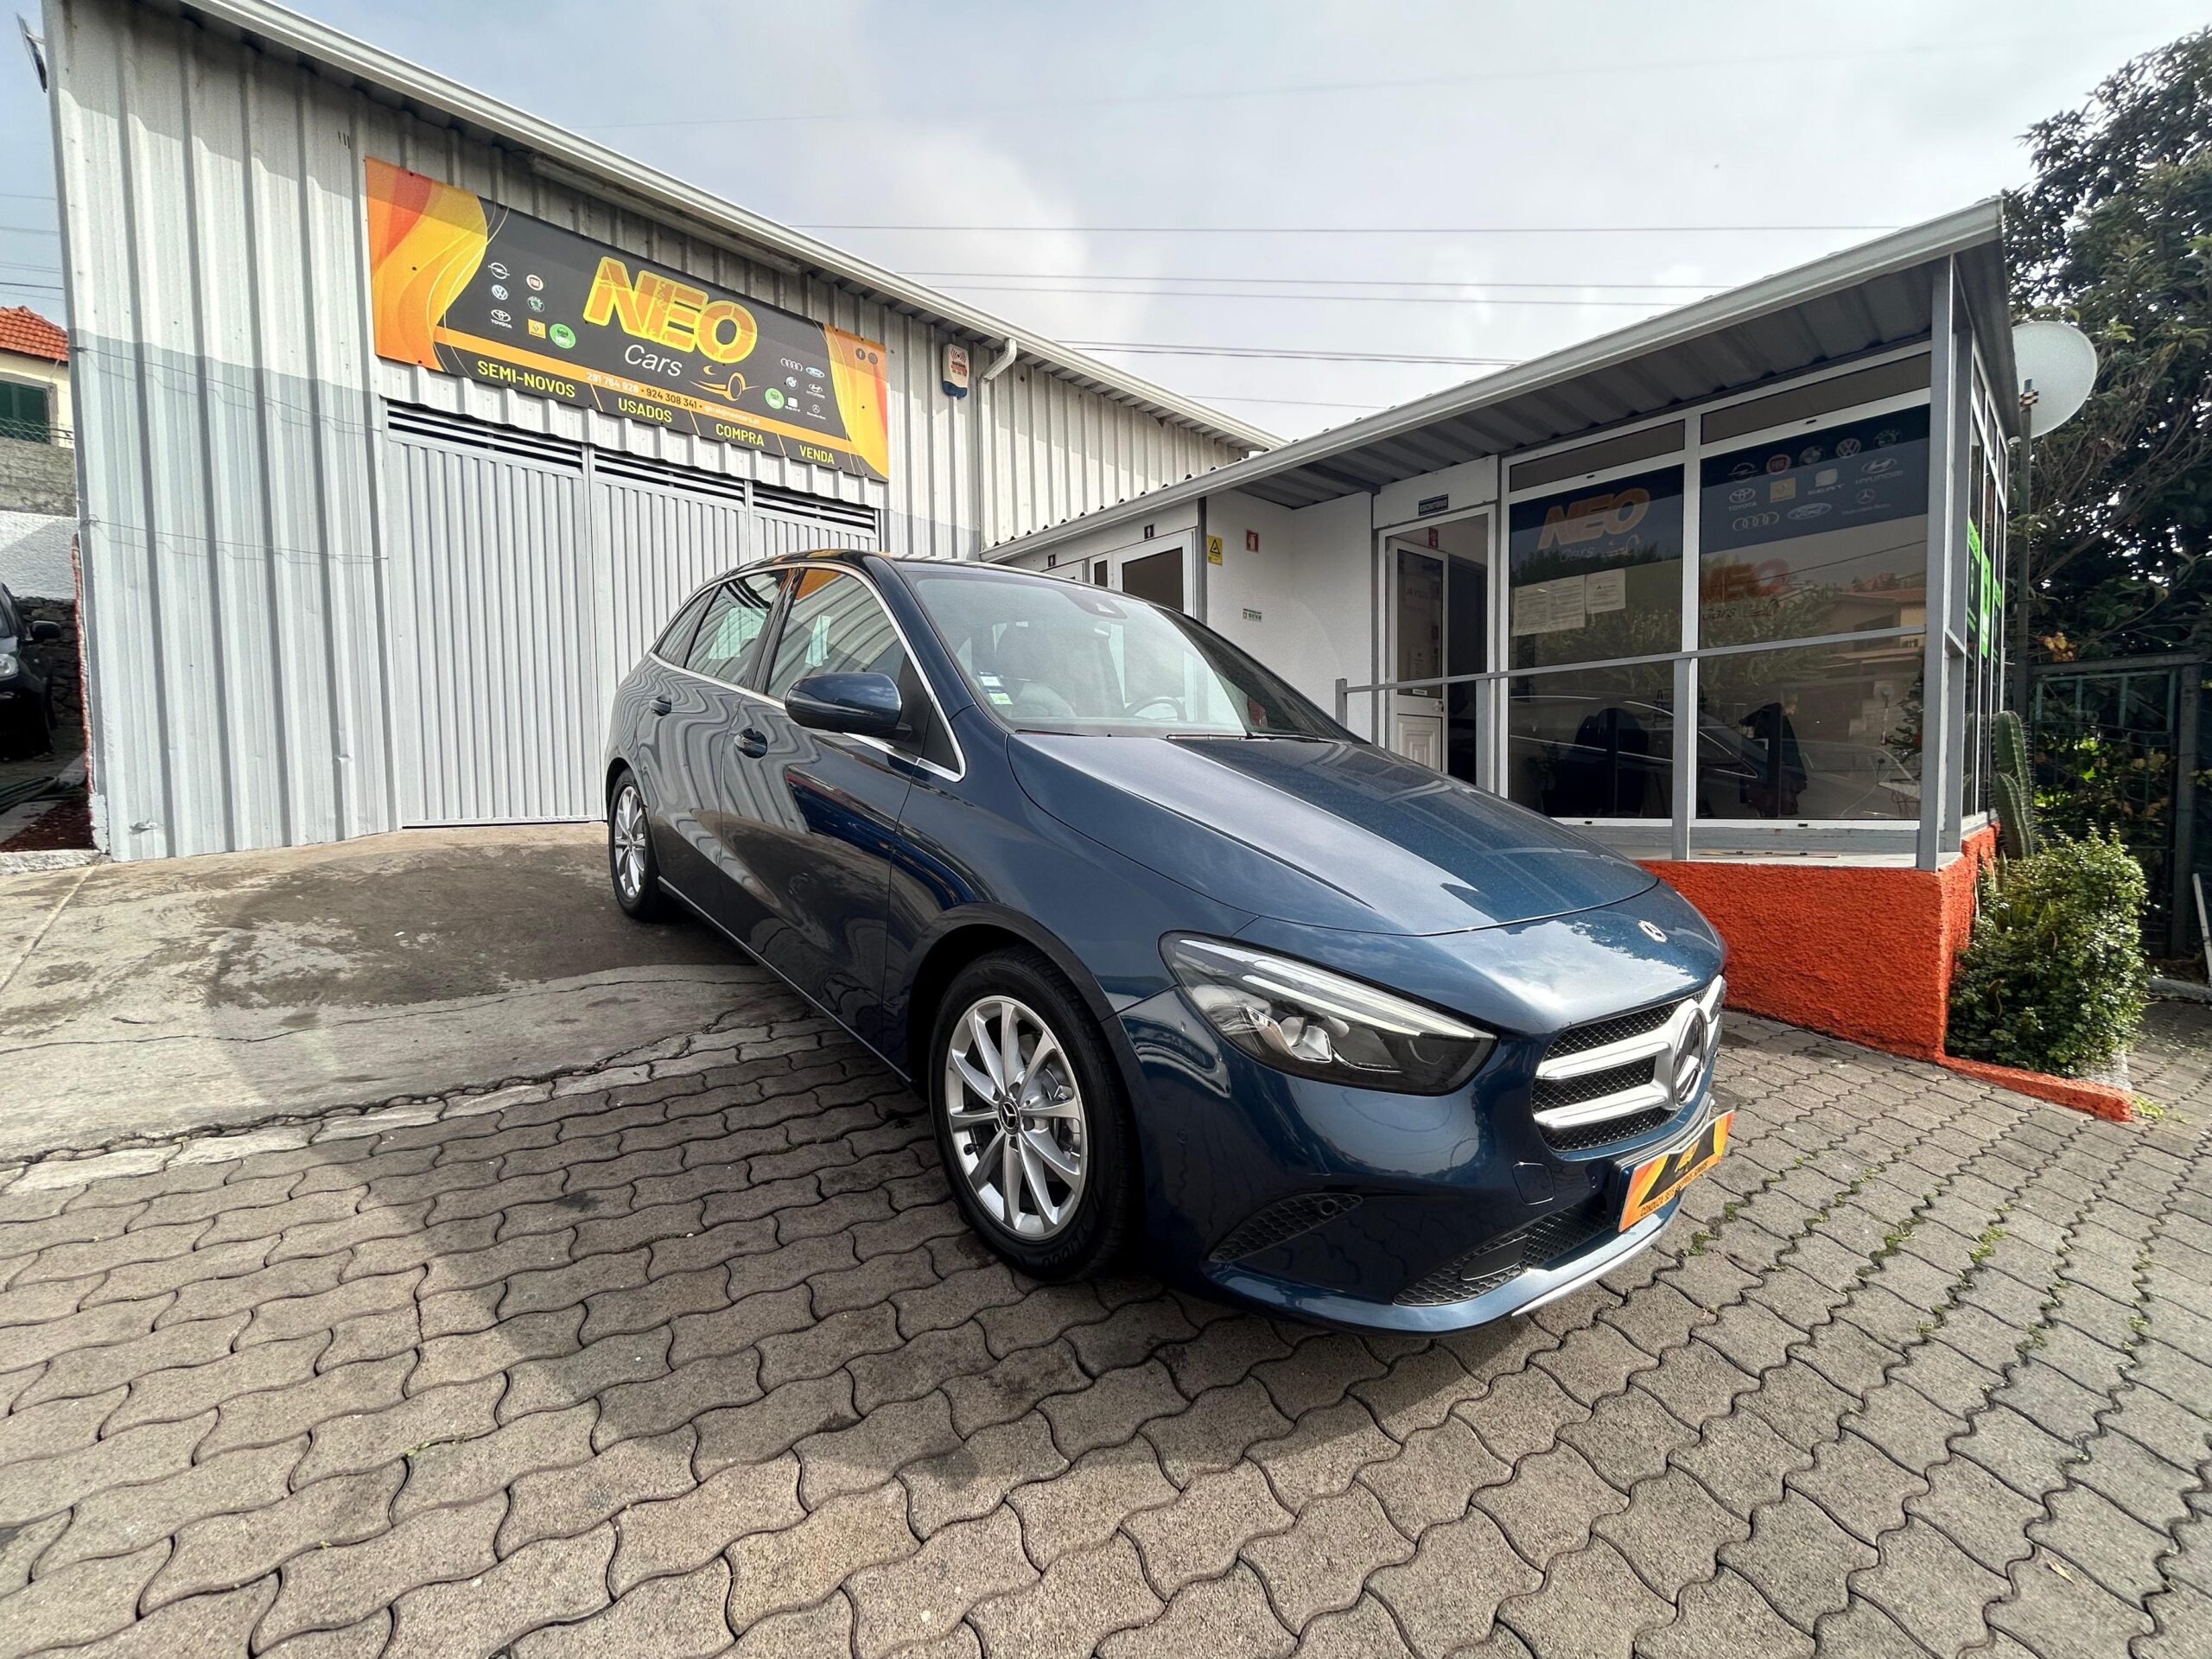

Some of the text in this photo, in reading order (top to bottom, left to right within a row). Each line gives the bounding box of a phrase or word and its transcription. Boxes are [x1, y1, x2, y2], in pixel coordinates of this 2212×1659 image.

[583, 257, 758, 364] NEO
[491, 319, 512, 328] TOYOTA
[625, 345, 683, 377] Cars
[477, 360, 575, 397] SEMI-NOVOS
[646, 388, 663, 400] 924
[665, 392, 681, 404] 308
[683, 397, 698, 409] 341
[618, 397, 672, 423] USADOS
[715, 423, 765, 447] COMPRA
[799, 444, 835, 465] VENDA
[1853, 469, 1903, 485] HYUNDAI
[1728, 501, 1758, 512] TOYOTA
[1537, 488, 1650, 550] NEO
[1560, 547, 1595, 563] Cars
[1702, 607, 1736, 620] Cars
